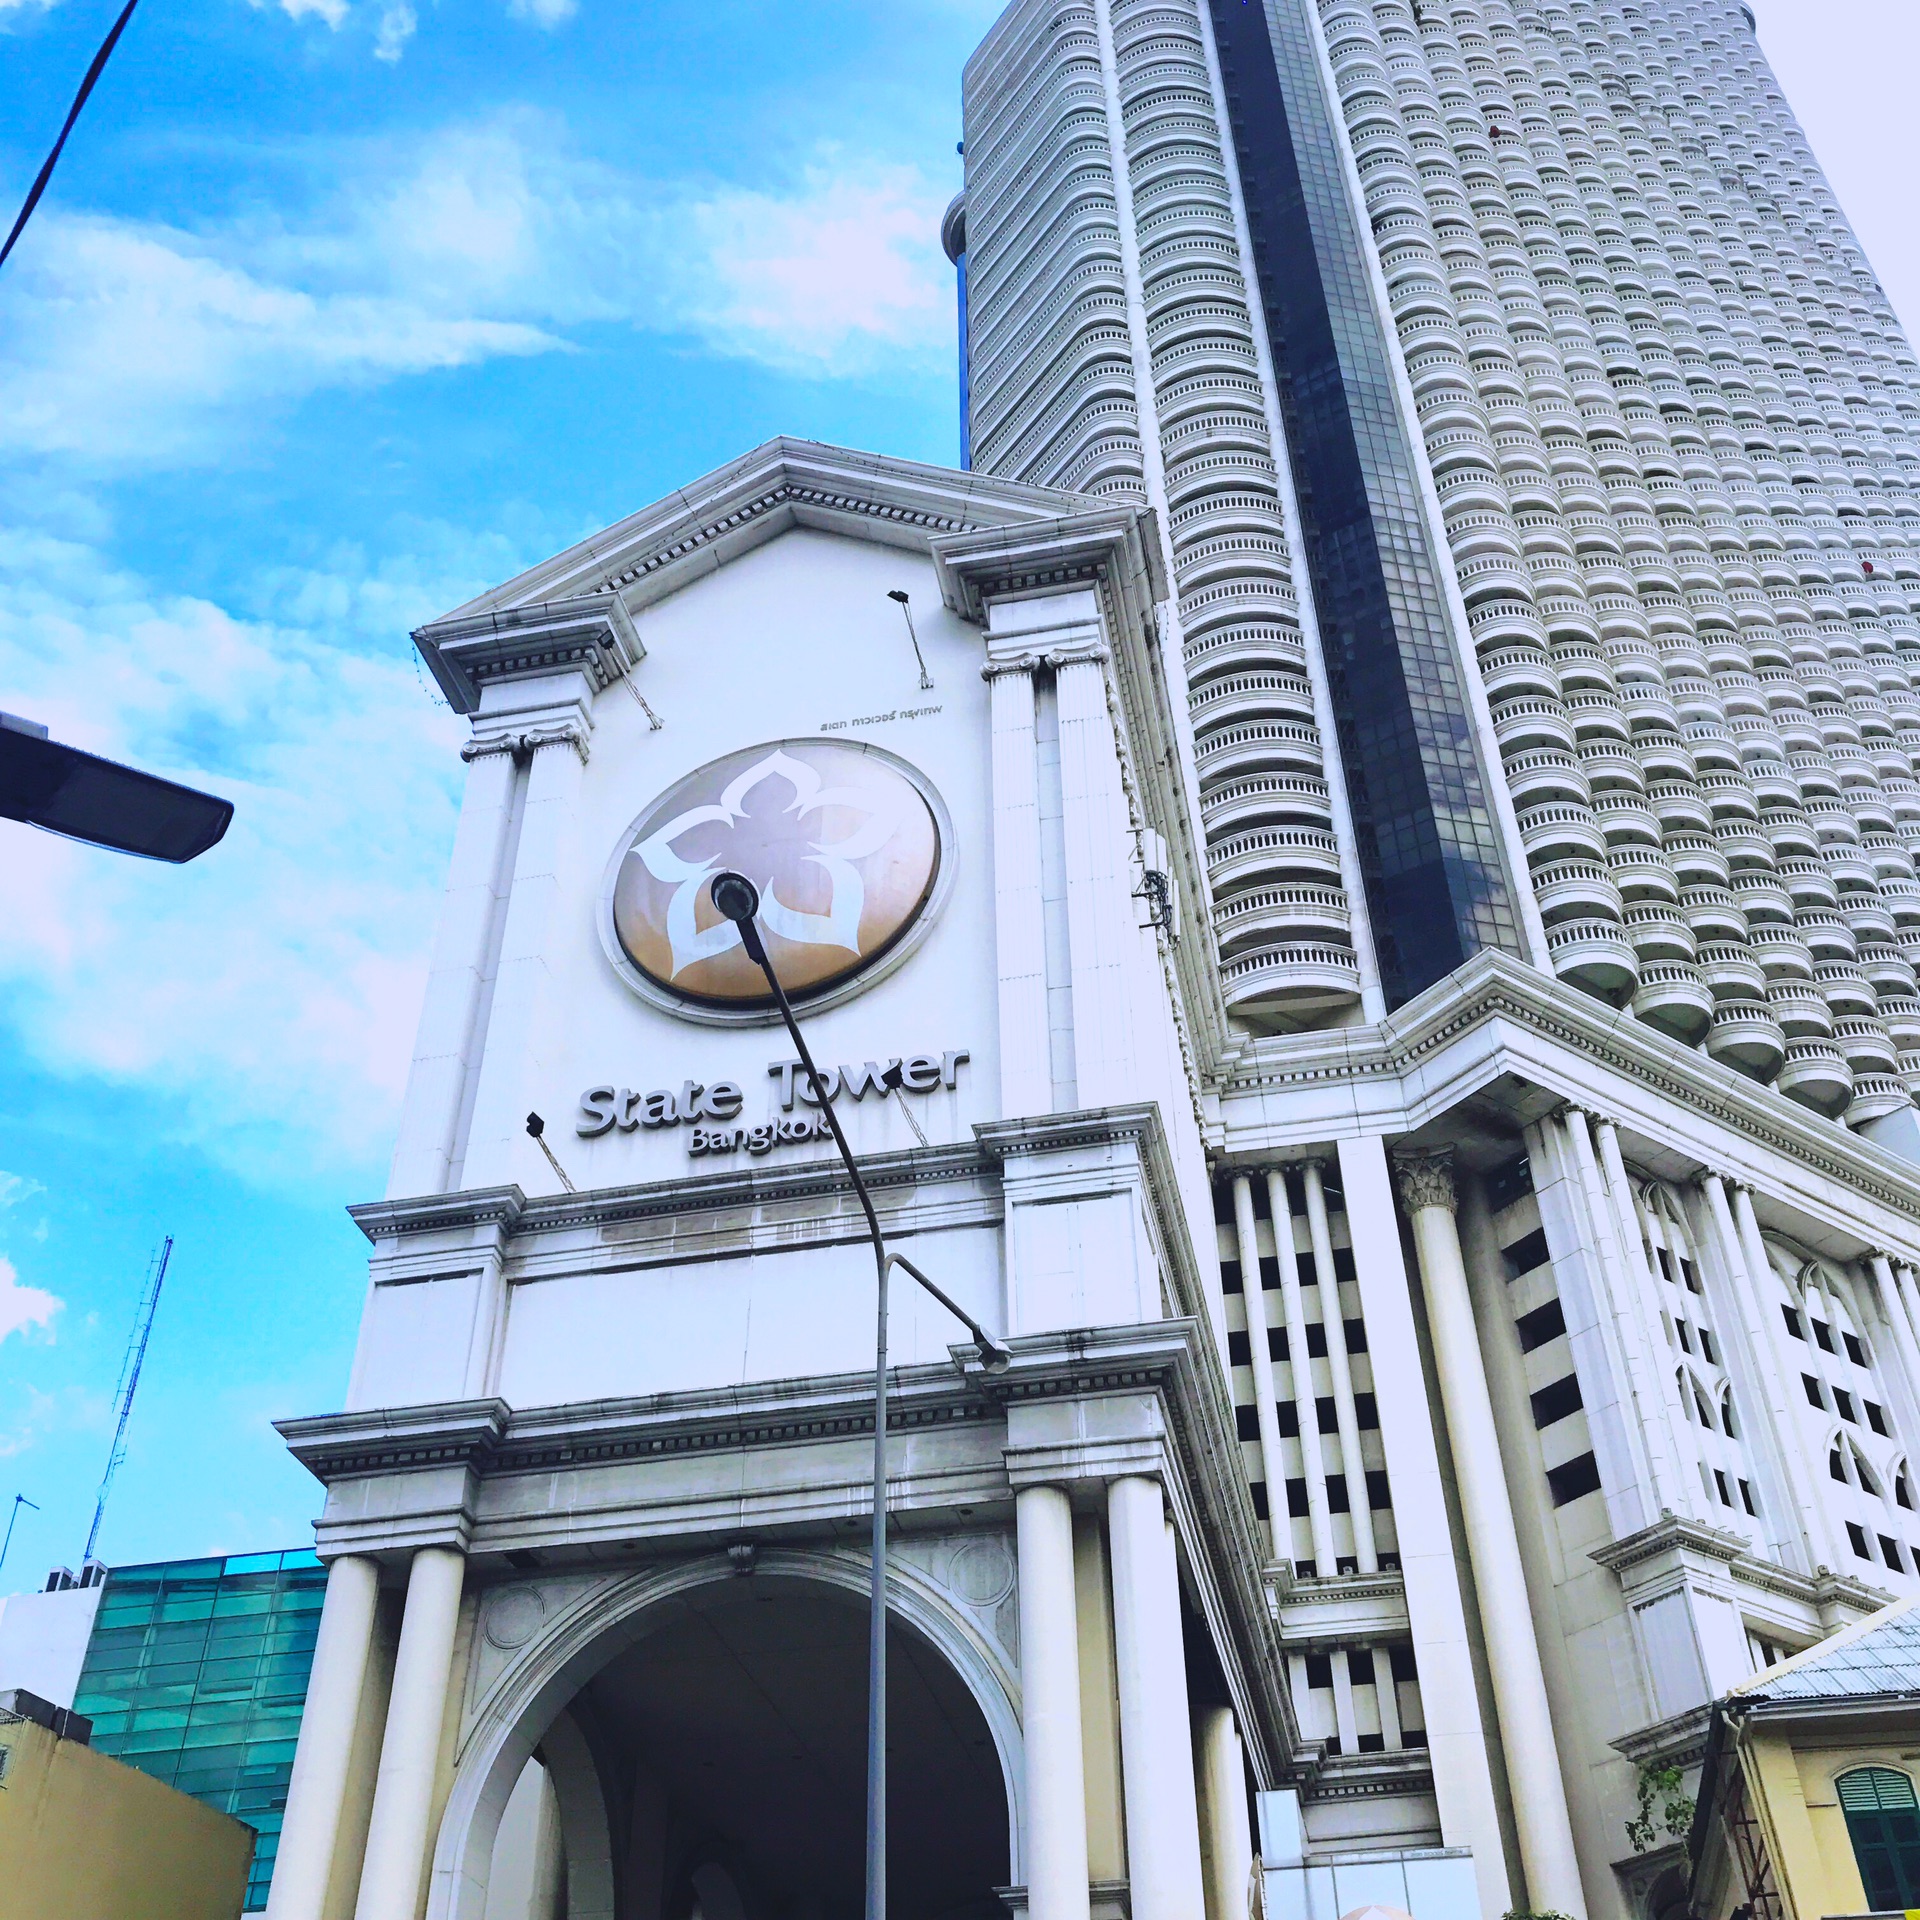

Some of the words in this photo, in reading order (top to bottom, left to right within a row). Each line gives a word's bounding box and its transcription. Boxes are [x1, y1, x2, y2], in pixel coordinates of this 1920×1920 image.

[576, 1079, 743, 1138] State
[767, 1048, 970, 1111] Tower
[688, 1112, 834, 1157] Bangkok
